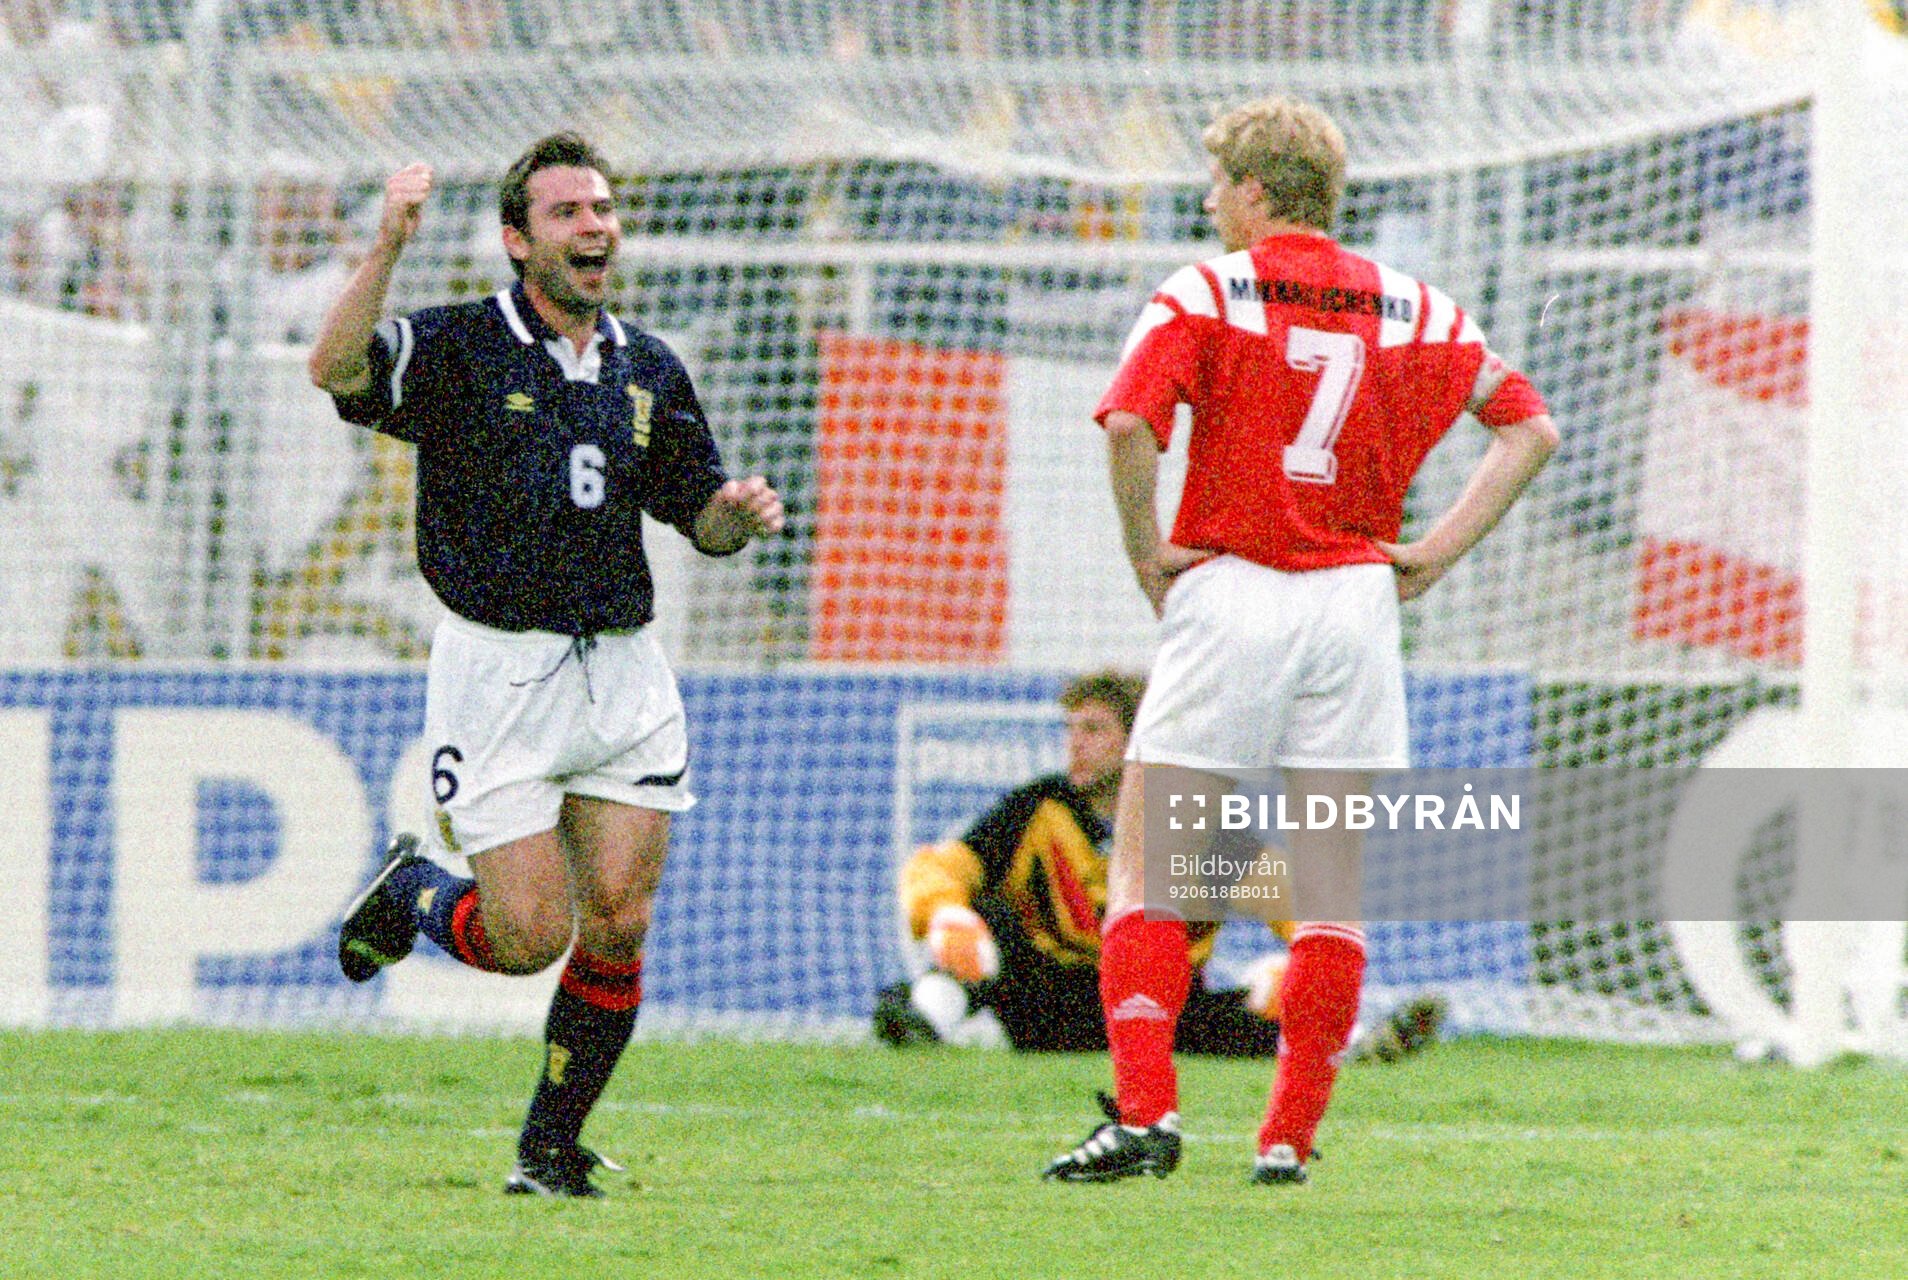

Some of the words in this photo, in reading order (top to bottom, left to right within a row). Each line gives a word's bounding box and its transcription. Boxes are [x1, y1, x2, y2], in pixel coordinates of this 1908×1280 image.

[1283, 325, 1367, 486] 7
[569, 443, 607, 509] 6
[432, 745, 464, 805] 6
